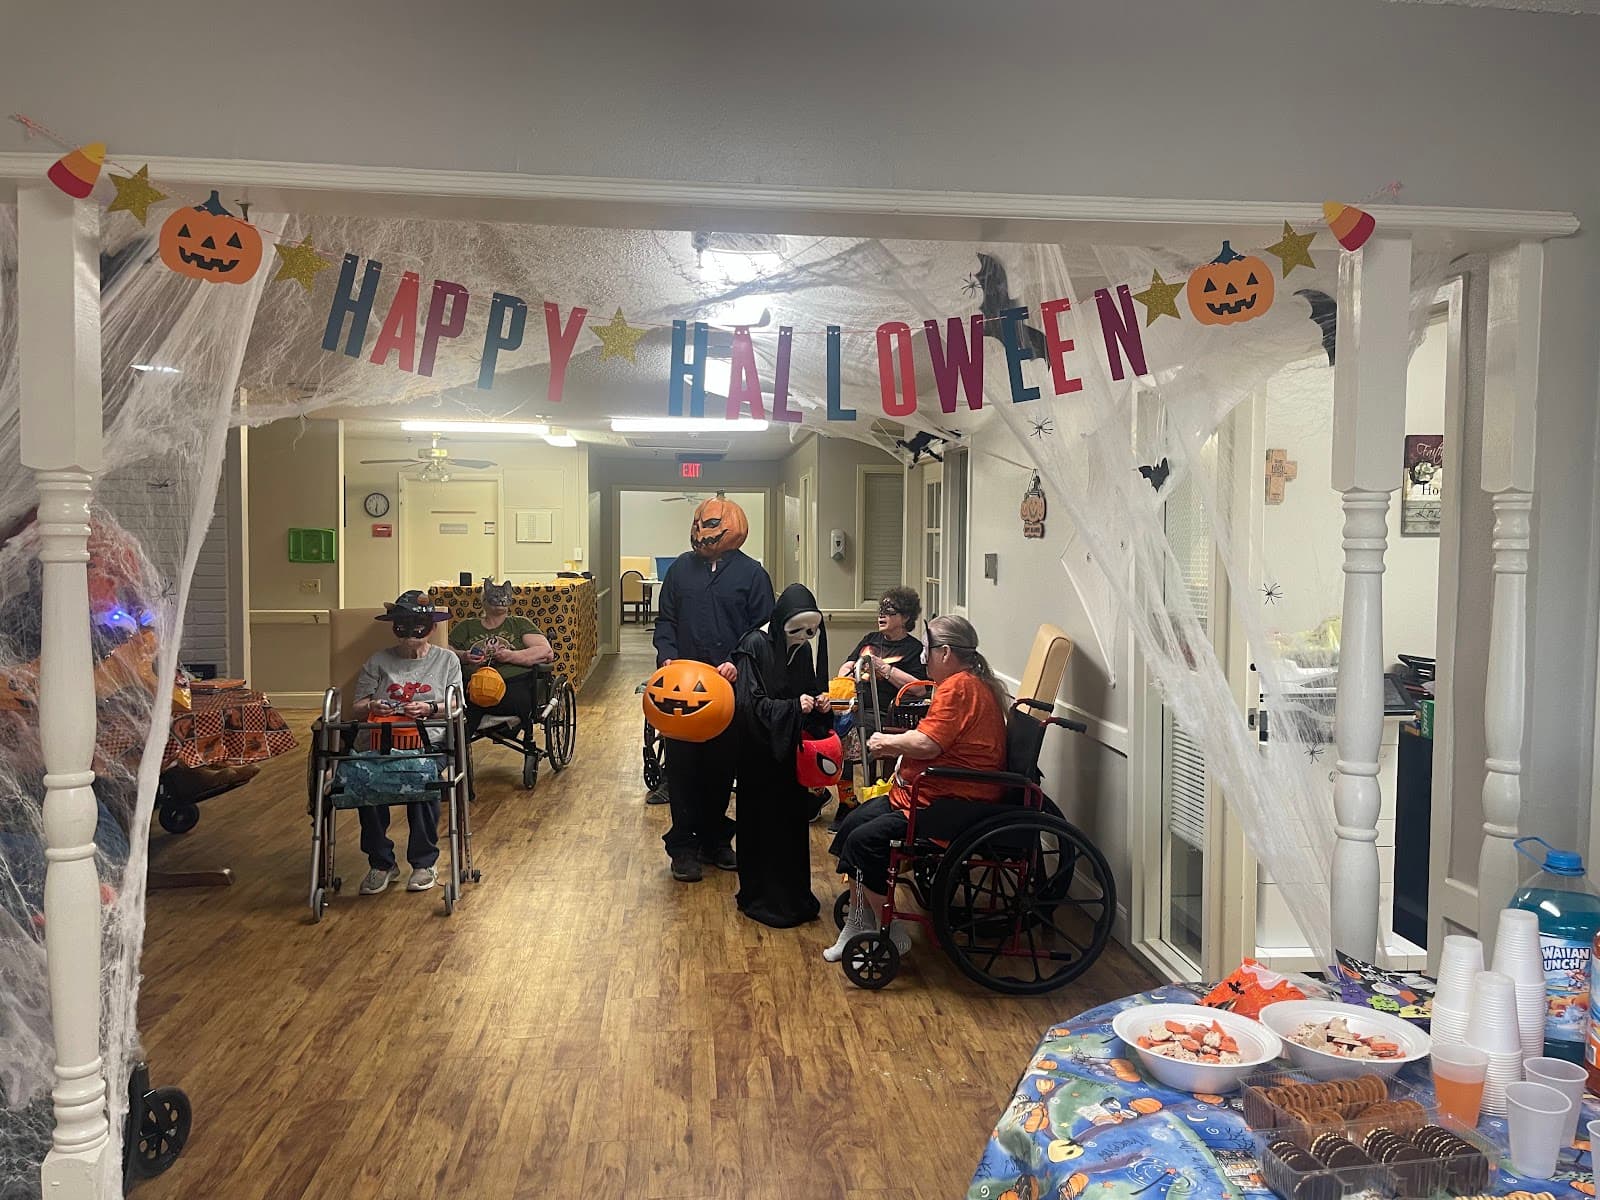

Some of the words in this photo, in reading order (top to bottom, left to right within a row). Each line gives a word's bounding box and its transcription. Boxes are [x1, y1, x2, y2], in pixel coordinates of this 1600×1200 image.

[322, 252, 588, 402] HAPPY
[668, 284, 1148, 423] HALLOWEEN
[682, 463, 700, 478] EXIT
[1422, 484, 1439, 496] Ho
[1541, 946, 1590, 960] WAIIAN
[1543, 959, 1580, 971] UNCH
